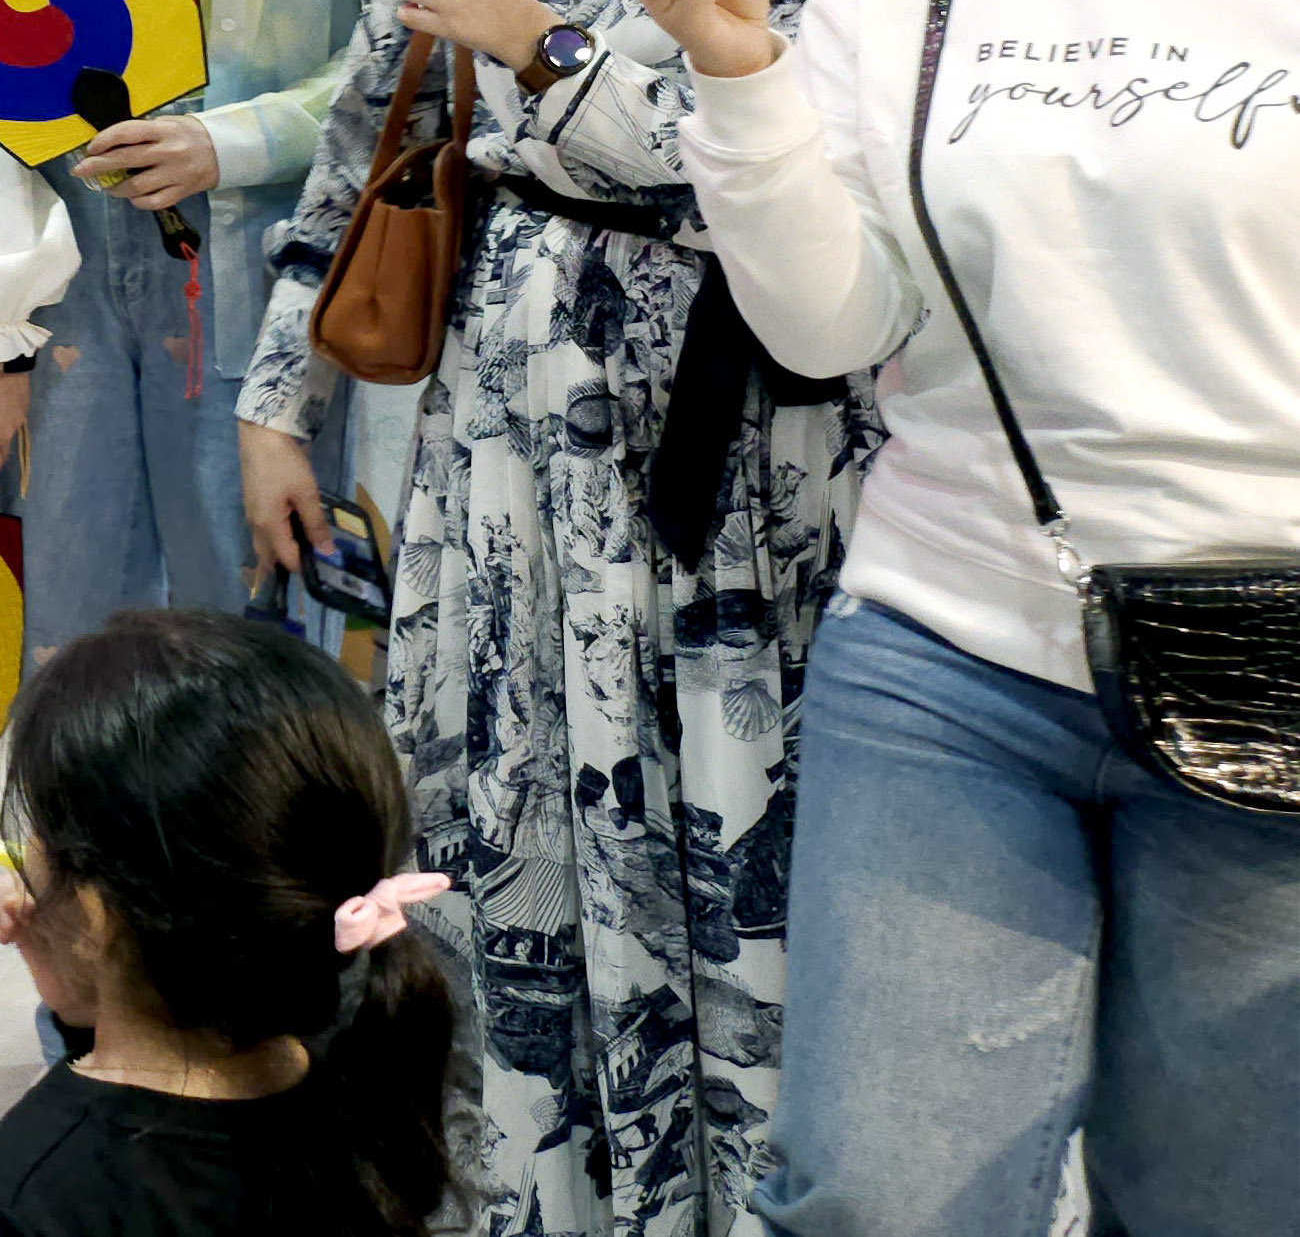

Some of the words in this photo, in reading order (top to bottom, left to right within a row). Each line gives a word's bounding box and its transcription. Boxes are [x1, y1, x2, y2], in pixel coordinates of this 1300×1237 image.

[976, 37, 1129, 62] BELIEVE
[1151, 43, 1190, 62] IN
[948, 61, 1290, 150] yourself
